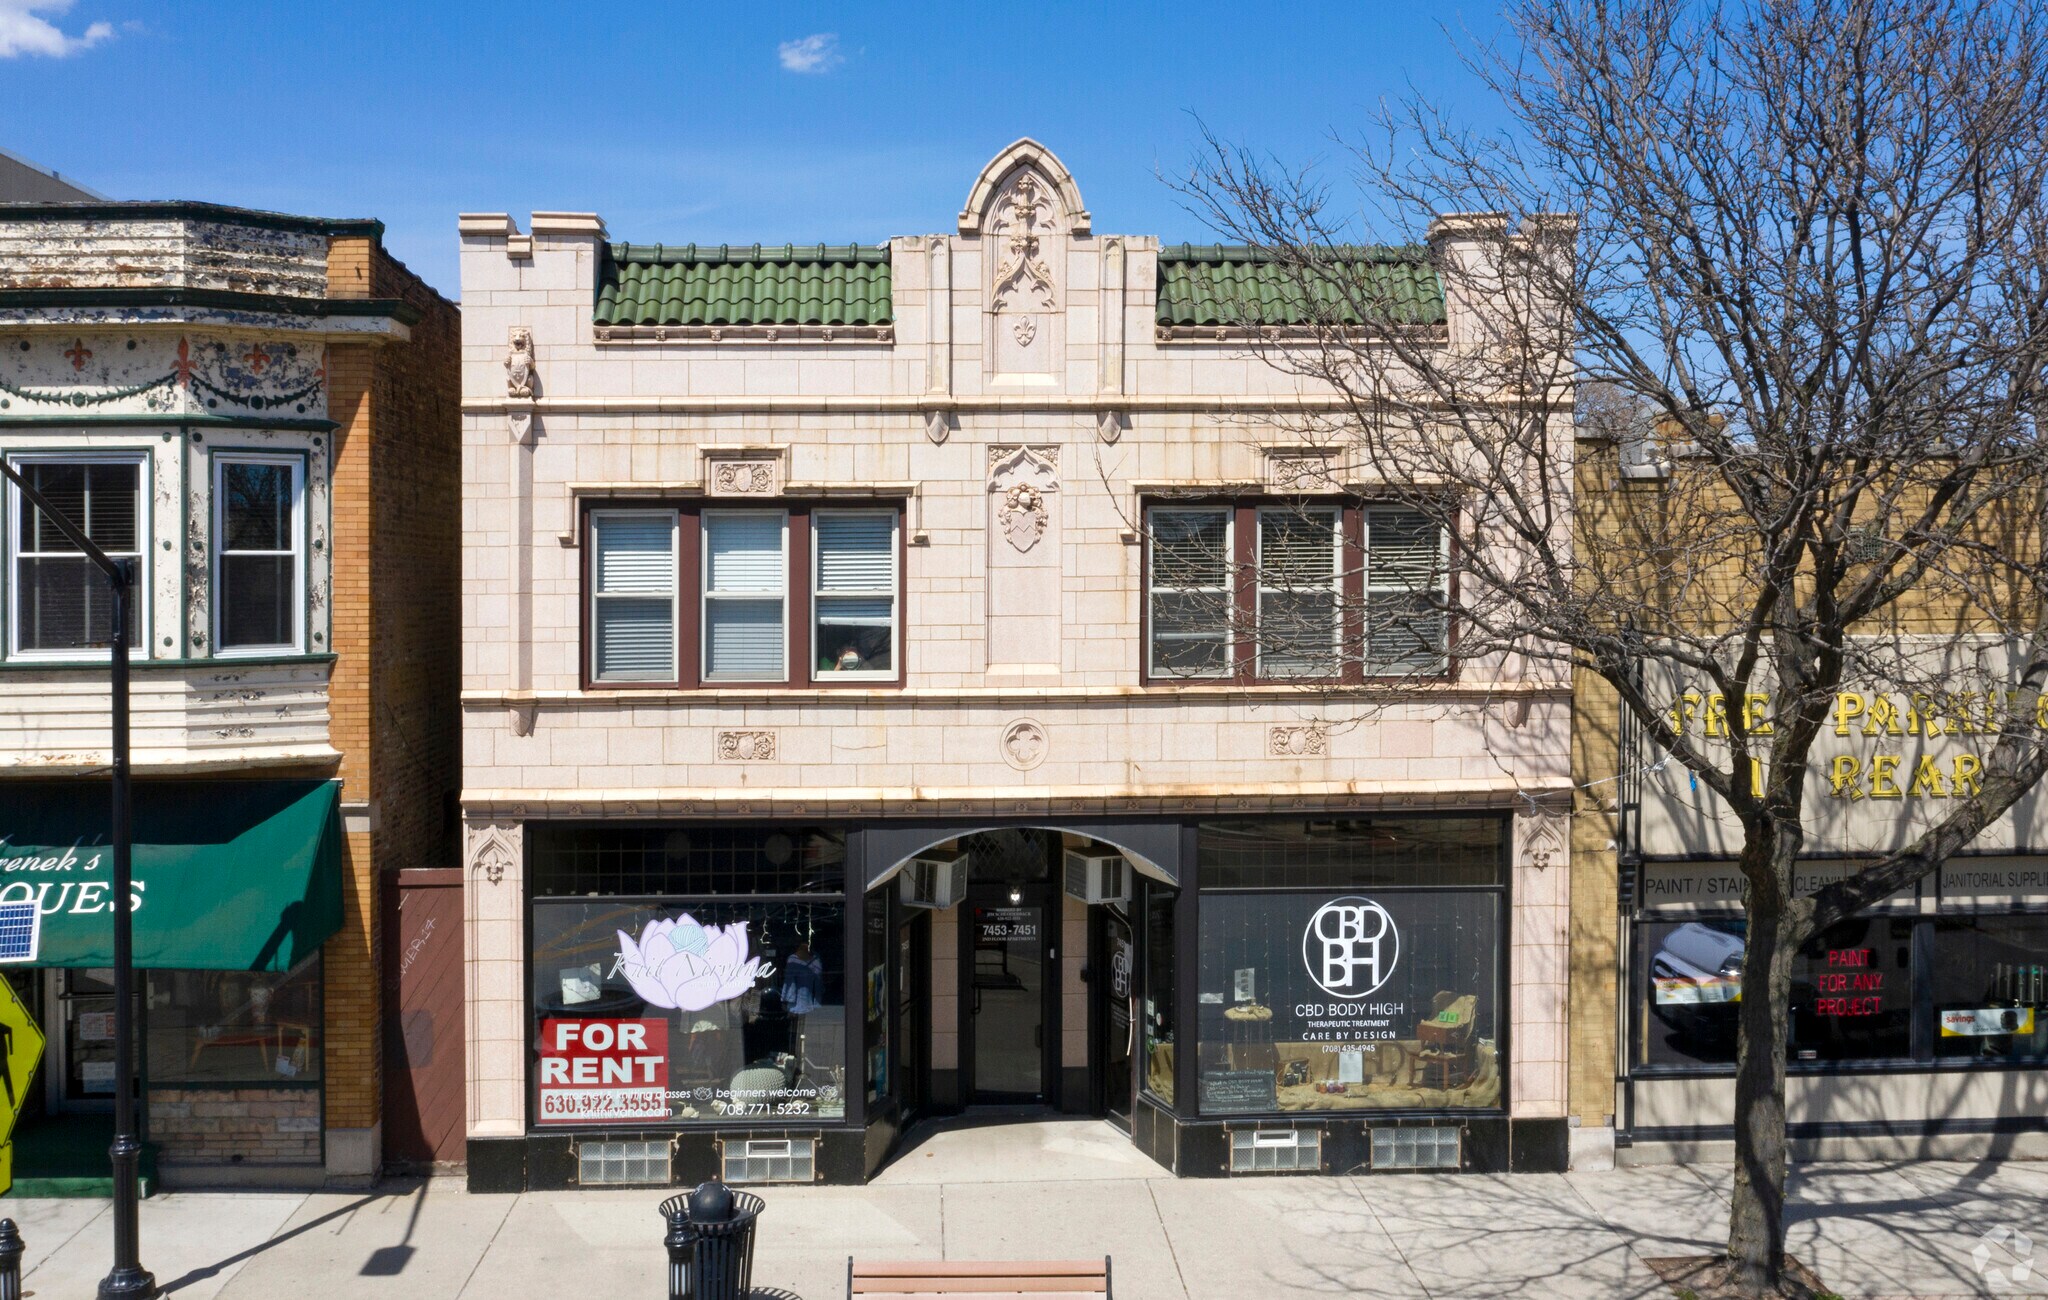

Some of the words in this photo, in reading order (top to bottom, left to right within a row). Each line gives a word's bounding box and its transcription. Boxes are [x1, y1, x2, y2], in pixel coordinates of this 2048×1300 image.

[1830, 754, 1982, 802] REAR
[1645, 878, 1693, 894] PAINT
[1943, 873, 2004, 888] JANITORIAL
[1314, 905, 1388, 943] CBD
[1828, 949, 1870, 967] PAINT
[1819, 974, 1846, 992] FOR
[1854, 973, 1883, 991] ANY
[1295, 1004, 1325, 1017] CBD
[1328, 1003, 1367, 1016] BODY
[1369, 1003, 1404, 1015] HIGH
[1817, 997, 1881, 1016] PROJECT
[1307, 1020, 1351, 1028] THERAPEUTIC
[1351, 1019, 1390, 1027] TREATMENT
[1946, 1015, 1976, 1024] savings
[556, 1023, 648, 1051] FOR
[1302, 1031, 1330, 1040] CARE
[1336, 1031, 1349, 1040] BY
[1355, 1031, 1396, 1040] DESIGN
[541, 1056, 664, 1084] RENT
[716, 1088, 766, 1101] beginners
[769, 1087, 817, 1098] welcome
[719, 1103, 810, 1116] 708.771.5232
